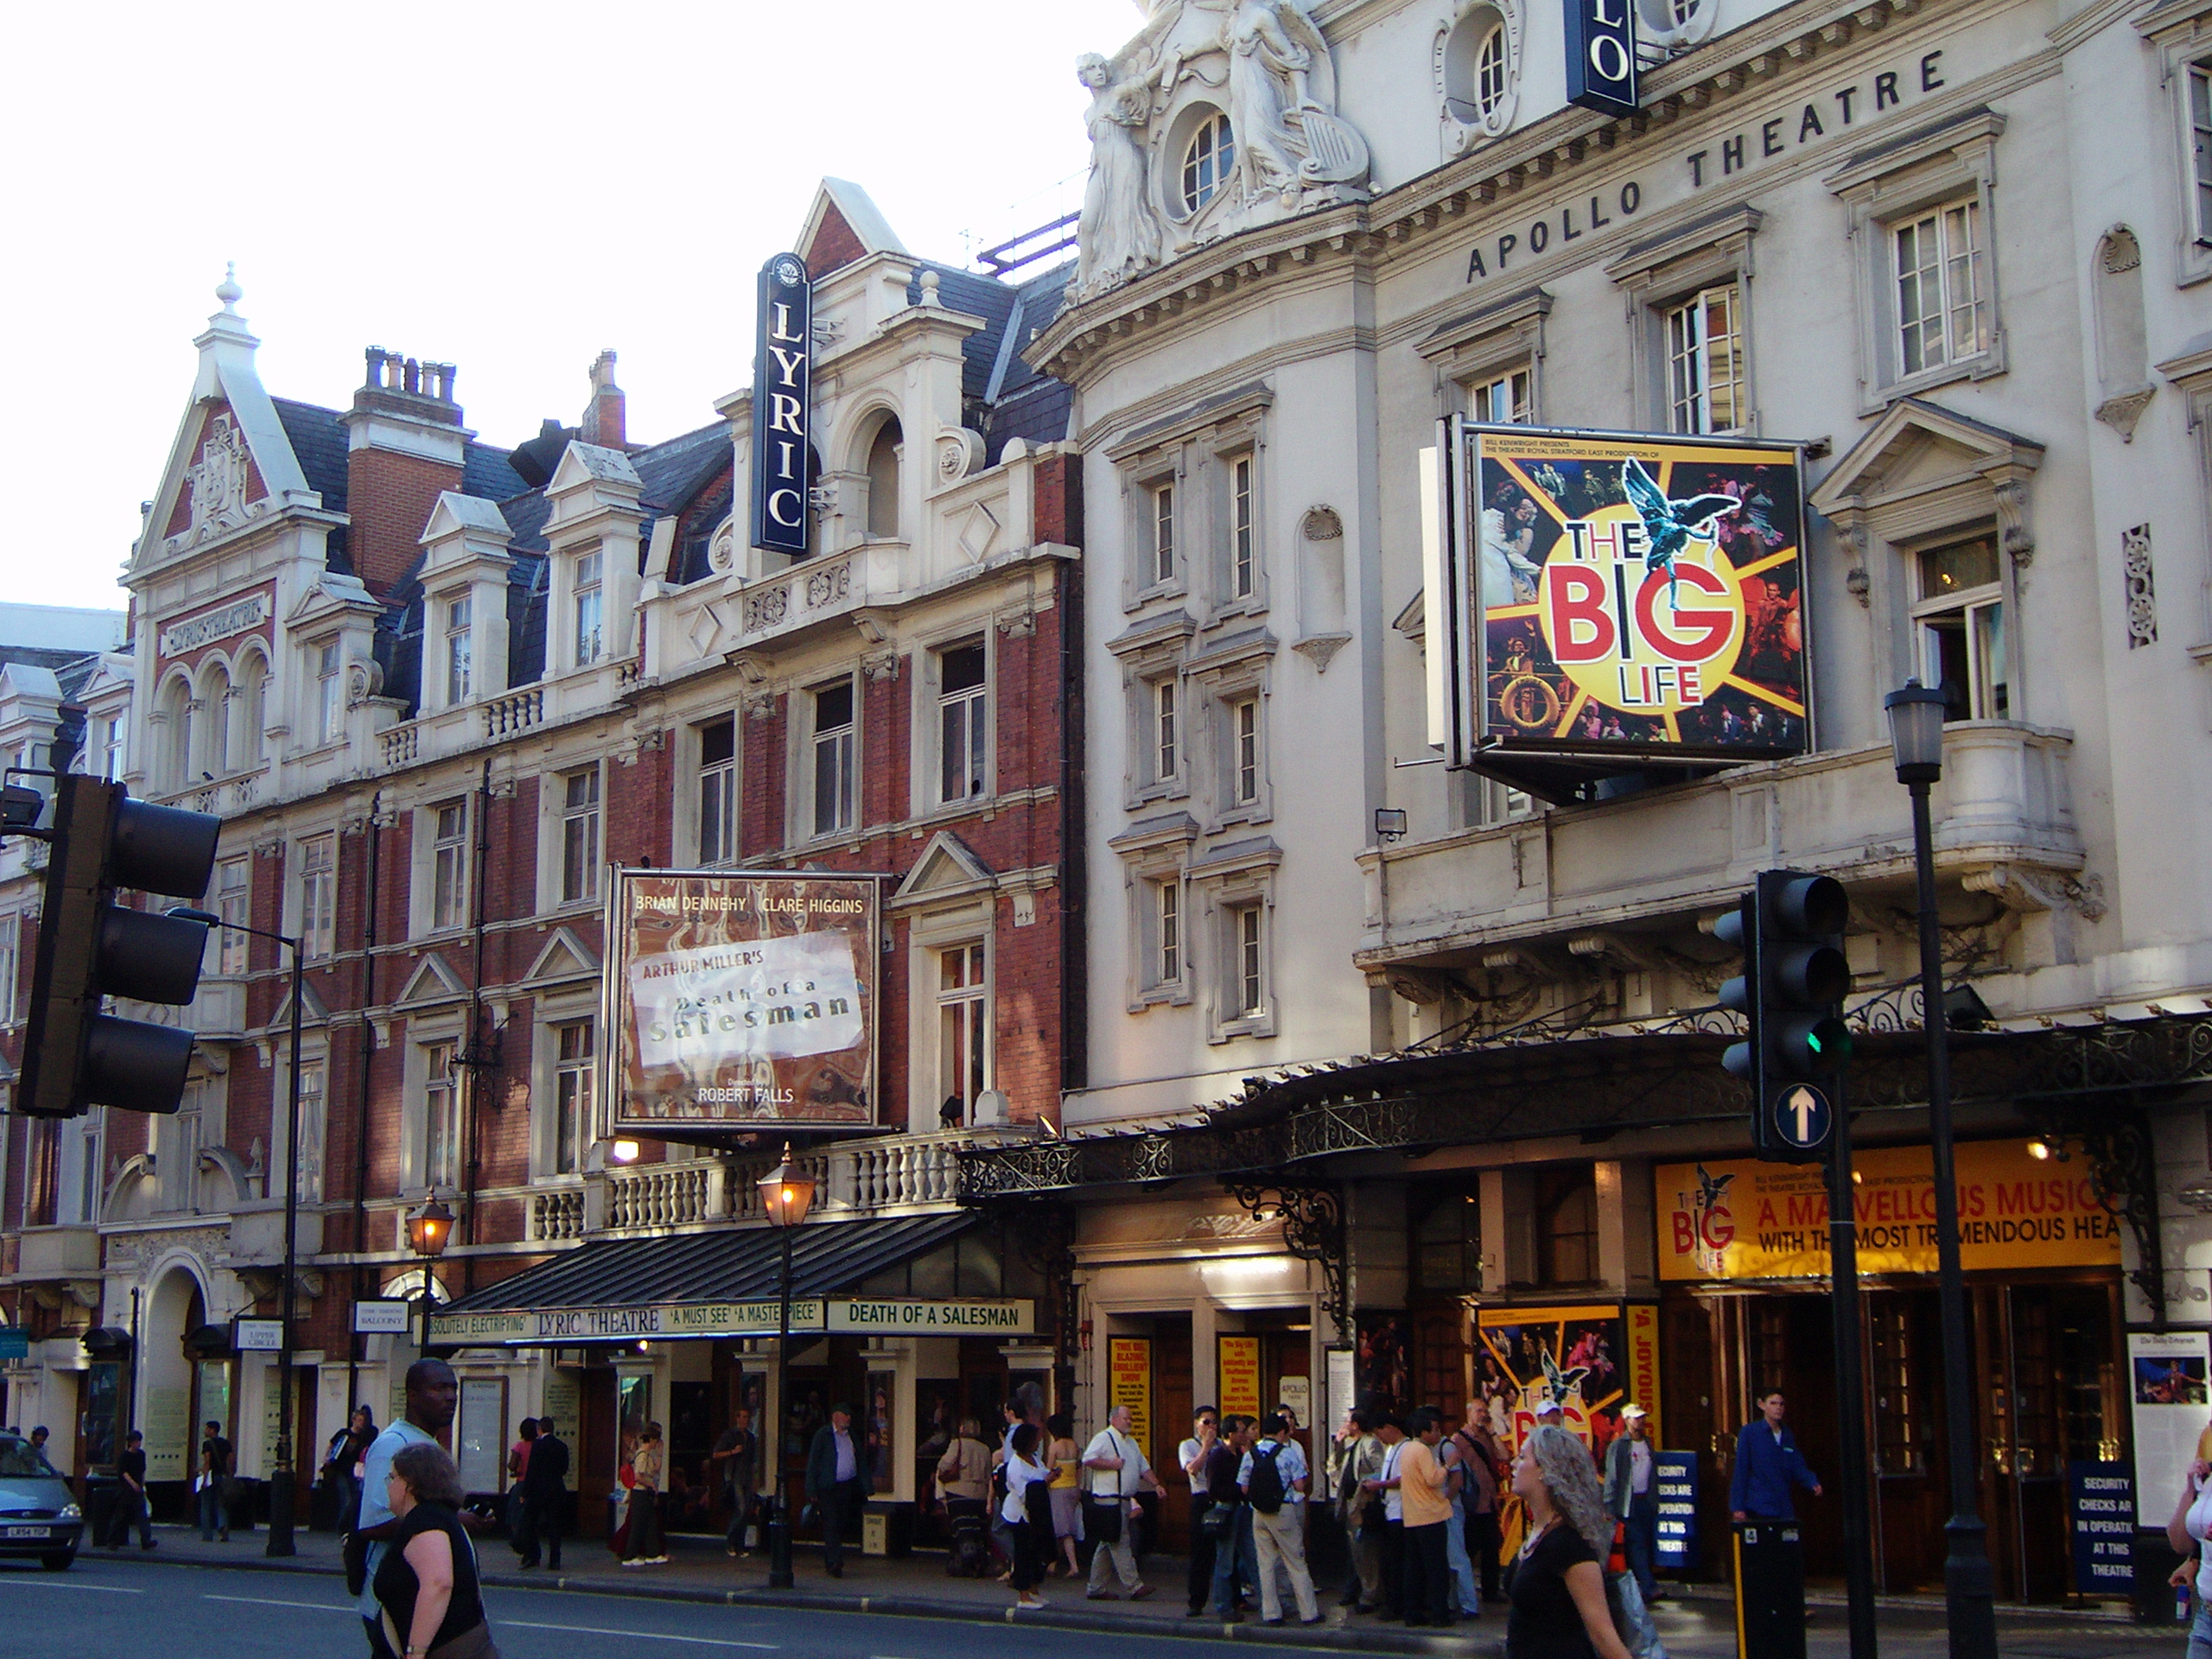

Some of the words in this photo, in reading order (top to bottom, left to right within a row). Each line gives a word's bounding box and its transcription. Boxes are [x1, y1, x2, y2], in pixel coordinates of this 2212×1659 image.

[1466, 181, 1640, 283] APOLLO
[1687, 49, 1944, 188] THEATRE
[769, 302, 805, 527] LYRIC
[1566, 523, 1643, 561] THE
[1548, 563, 1735, 662] BIG
[1618, 665, 1700, 705] LIFE
[635, 895, 677, 910] BRIAN
[682, 896, 747, 912] DENNEHY
[762, 898, 804, 912] CLARE
[809, 899, 863, 913] HIGGINS
[642, 958, 700, 979] ARTHUR
[702, 950, 765, 971] MILLER'S
[698, 1087, 751, 1103] ROBERT
[754, 1088, 794, 1103] FALLS
[1678, 1190, 1703, 1208] THE
[1788, 1184, 1986, 1226] MAVELLOUS
[1997, 1179, 2115, 1215] MUSIC
[1672, 1205, 1735, 1254] BIG
[1758, 1230, 1805, 1252] WITH
[1811, 1229, 1832, 1251] TH
[1916, 1217, 2066, 1249] TRMENDOUS
[1697, 1252, 1724, 1271] LIFE
[538, 1313, 581, 1336] LYRIC
[588, 1309, 659, 1334] THEATRE
[683, 1307, 708, 1324] MUST
[747, 1303, 817, 1321] MASTEPIECE'
[849, 1303, 897, 1323] DEATH
[903, 1305, 923, 1323] OF
[927, 1306, 937, 1324] A
[943, 1306, 1019, 1326] SALESMAN
[429, 1318, 468, 1335] BSOLUTELY
[1282, 1384, 1307, 1394] APOLLO
[1657, 1465, 1687, 1477] ECURITY
[2083, 1477, 2130, 1490] SECURITY
[2079, 1498, 2116, 1512] CHECKS
[2093, 1541, 2106, 1554] AT
[2107, 1541, 2130, 1555] THIS
[2091, 1563, 2133, 1578] THEATRE
